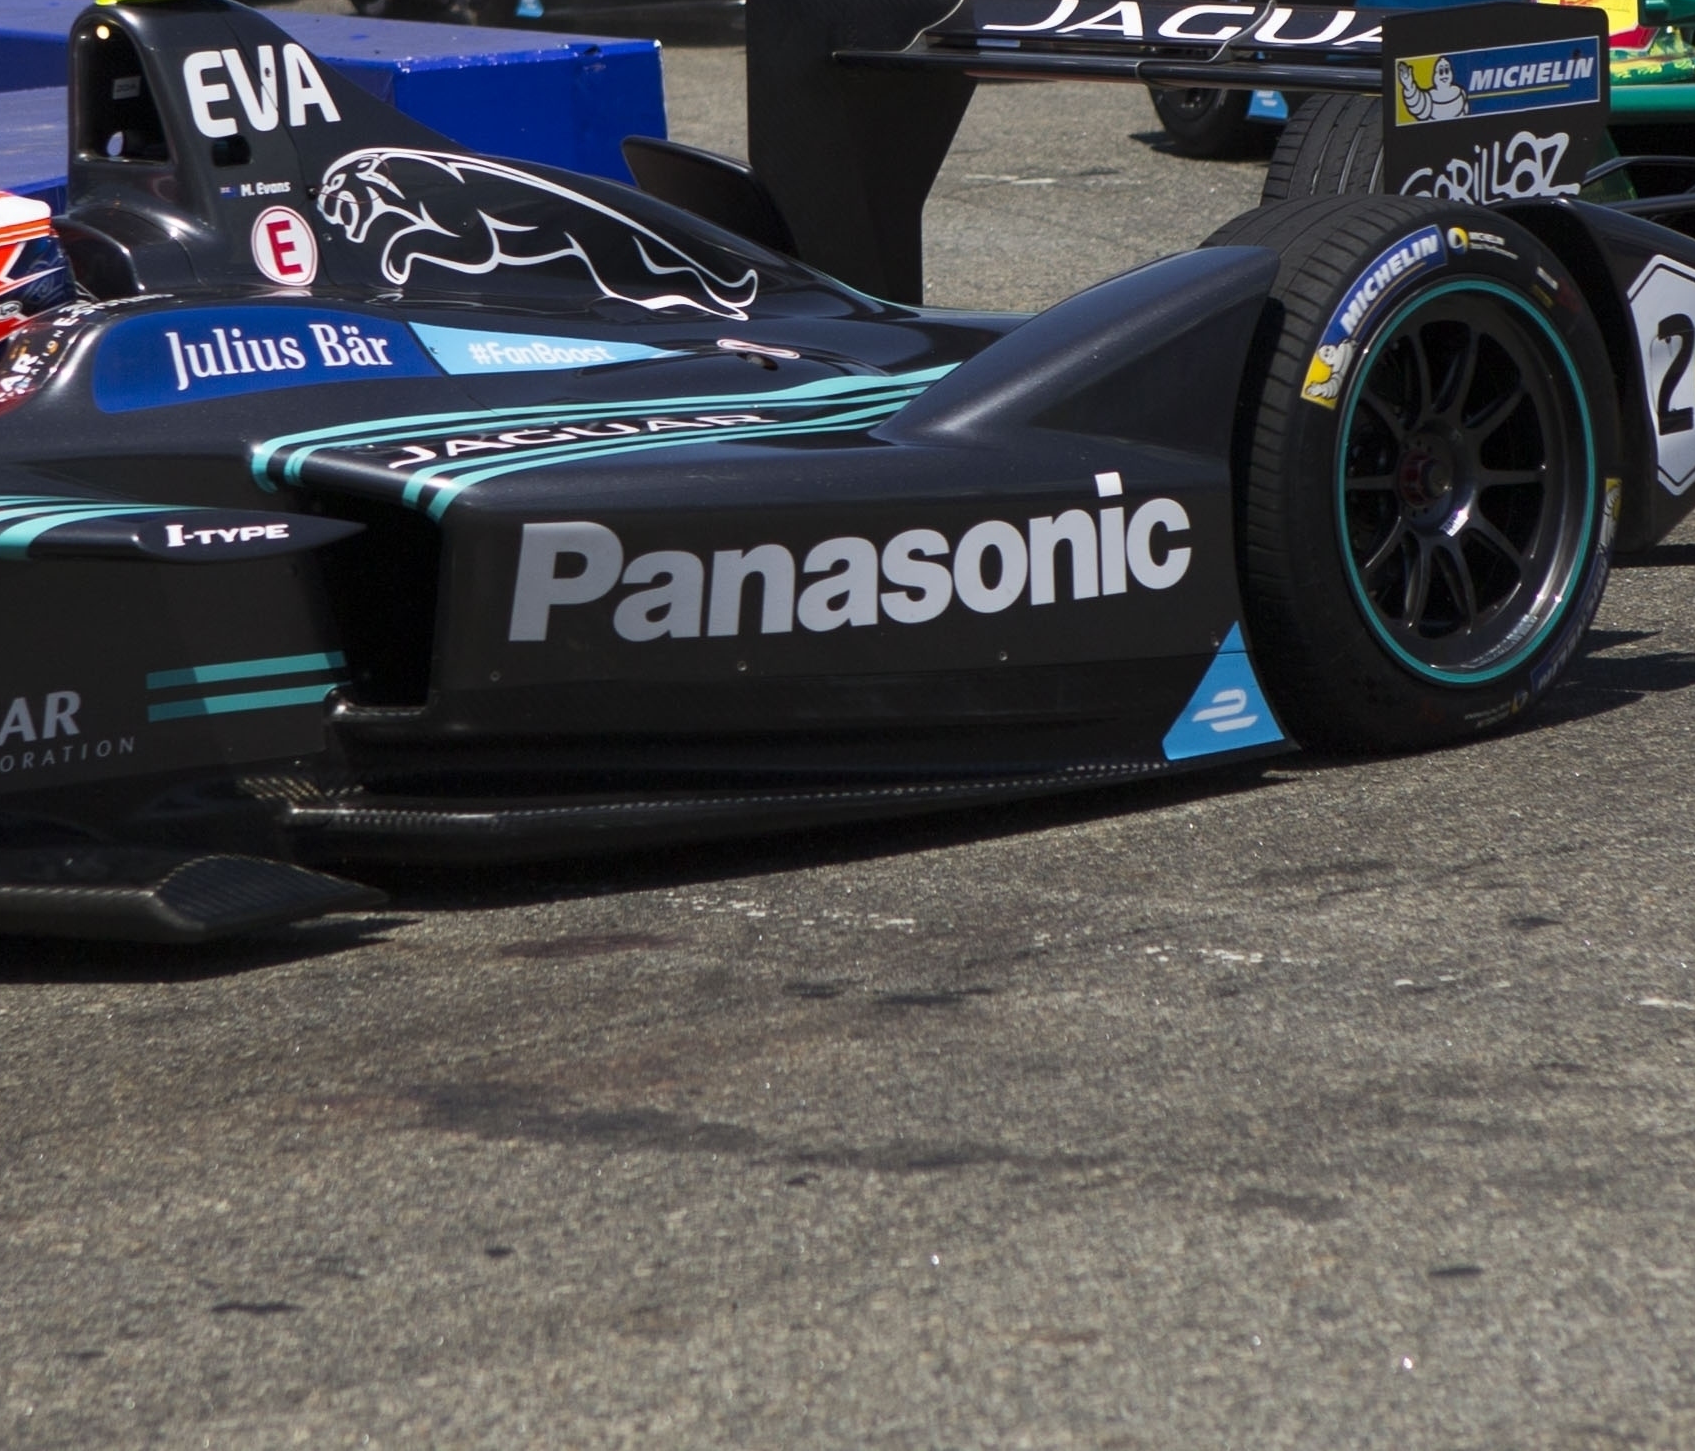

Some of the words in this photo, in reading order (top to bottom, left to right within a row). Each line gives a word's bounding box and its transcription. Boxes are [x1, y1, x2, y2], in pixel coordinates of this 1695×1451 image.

[182, 42, 342, 139] EVA
[1468, 55, 1595, 93] MICHELIN
[256, 181, 292, 196] Evans
[266, 219, 304, 276] E
[1340, 233, 1440, 335] MICHELIN
[164, 326, 307, 391] Julius
[309, 321, 394, 369] Bär
[469, 341, 611, 367] #FanBoost
[388, 413, 779, 470] JAGUAR
[165, 522, 291, 548] I-TYPE
[507, 471, 1192, 643] Panasonic
